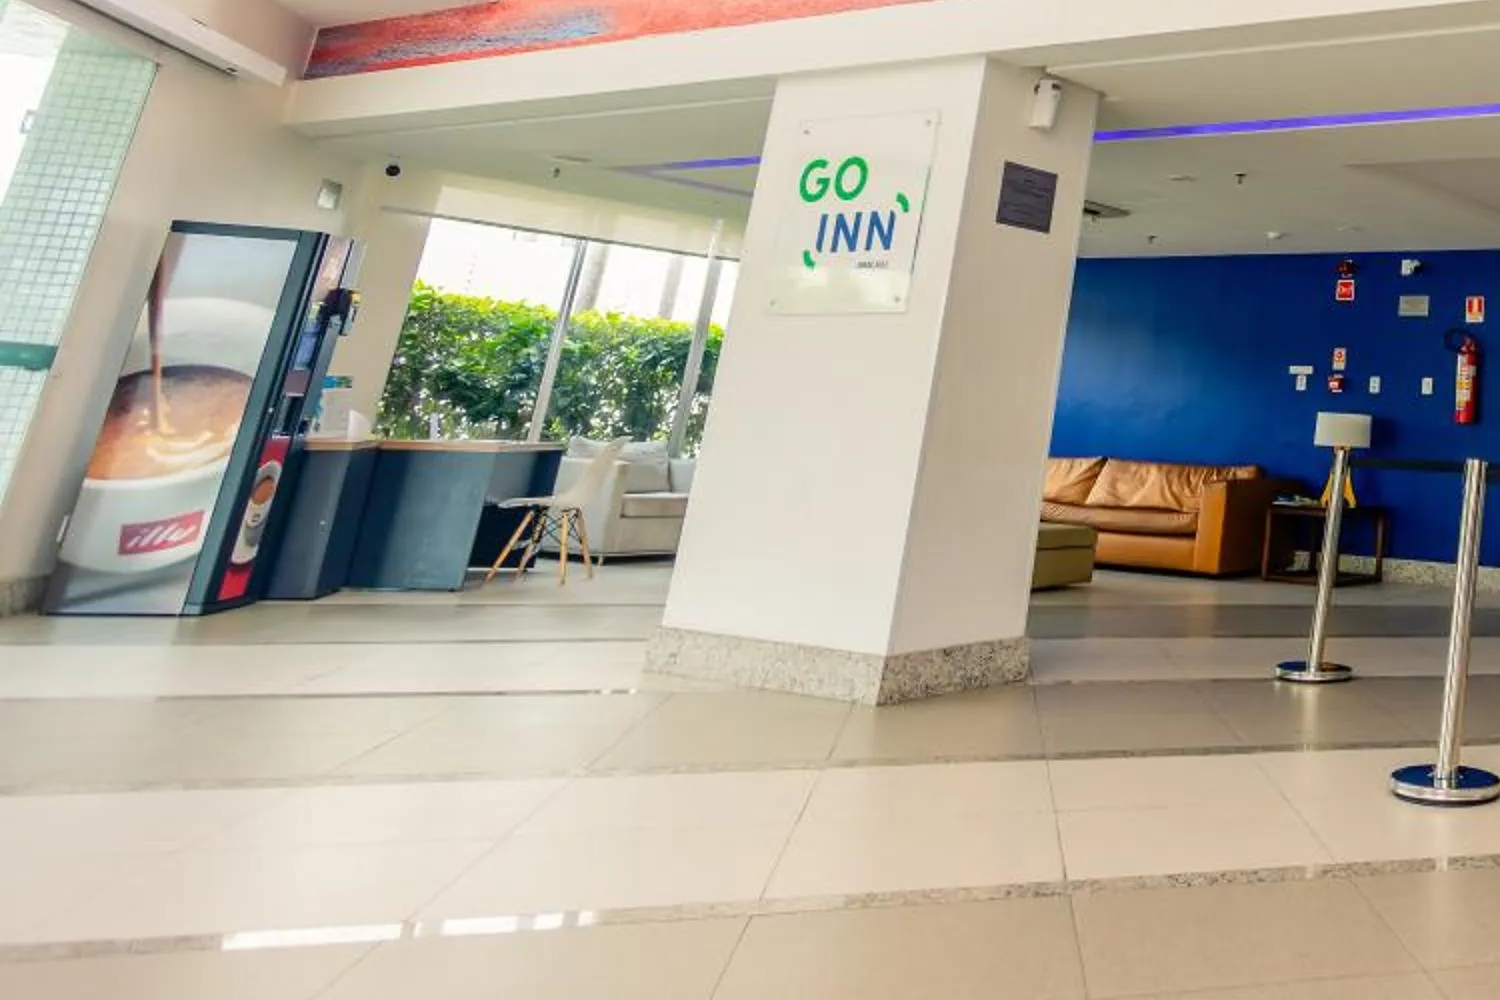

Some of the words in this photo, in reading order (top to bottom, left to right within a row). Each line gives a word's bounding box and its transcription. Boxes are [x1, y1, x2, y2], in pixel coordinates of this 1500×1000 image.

[800, 155, 869, 203] GO
[814, 209, 897, 254] INN
[126, 522, 198, 549] illy
